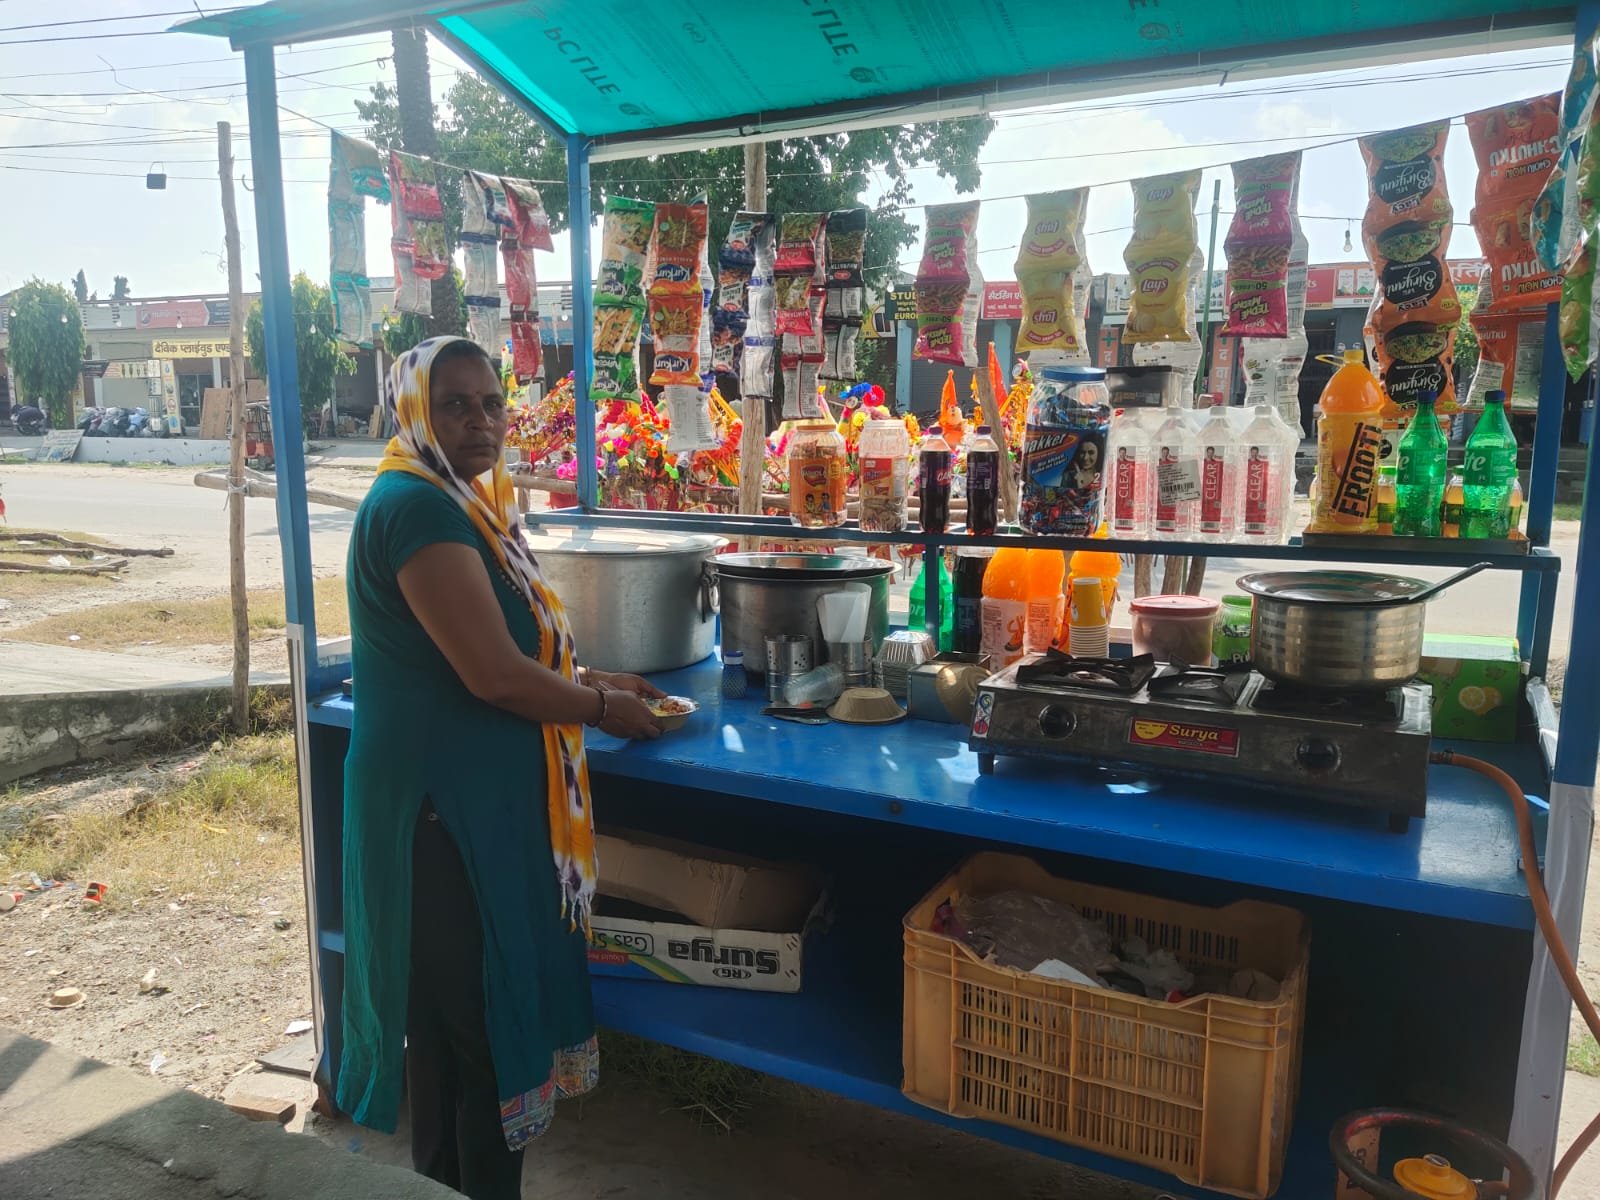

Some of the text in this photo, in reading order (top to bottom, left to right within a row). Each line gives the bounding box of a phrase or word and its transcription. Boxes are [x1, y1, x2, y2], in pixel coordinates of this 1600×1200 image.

[1378, 166, 1432, 196] Biryani
[1386, 267, 1438, 298] Biryani
[154, 341, 178, 354] दैविक
[180, 341, 213, 357] प्लाईवुड
[1390, 368, 1442, 397] Biryani
[1118, 462, 1130, 498] CLEAR
[1205, 462, 1217, 500] CLEAR
[1249, 461, 1263, 500] CLEAR
[1168, 724, 1219, 742] Surya
[614, 934, 648, 953] Gas
[667, 936, 781, 976] Surya
